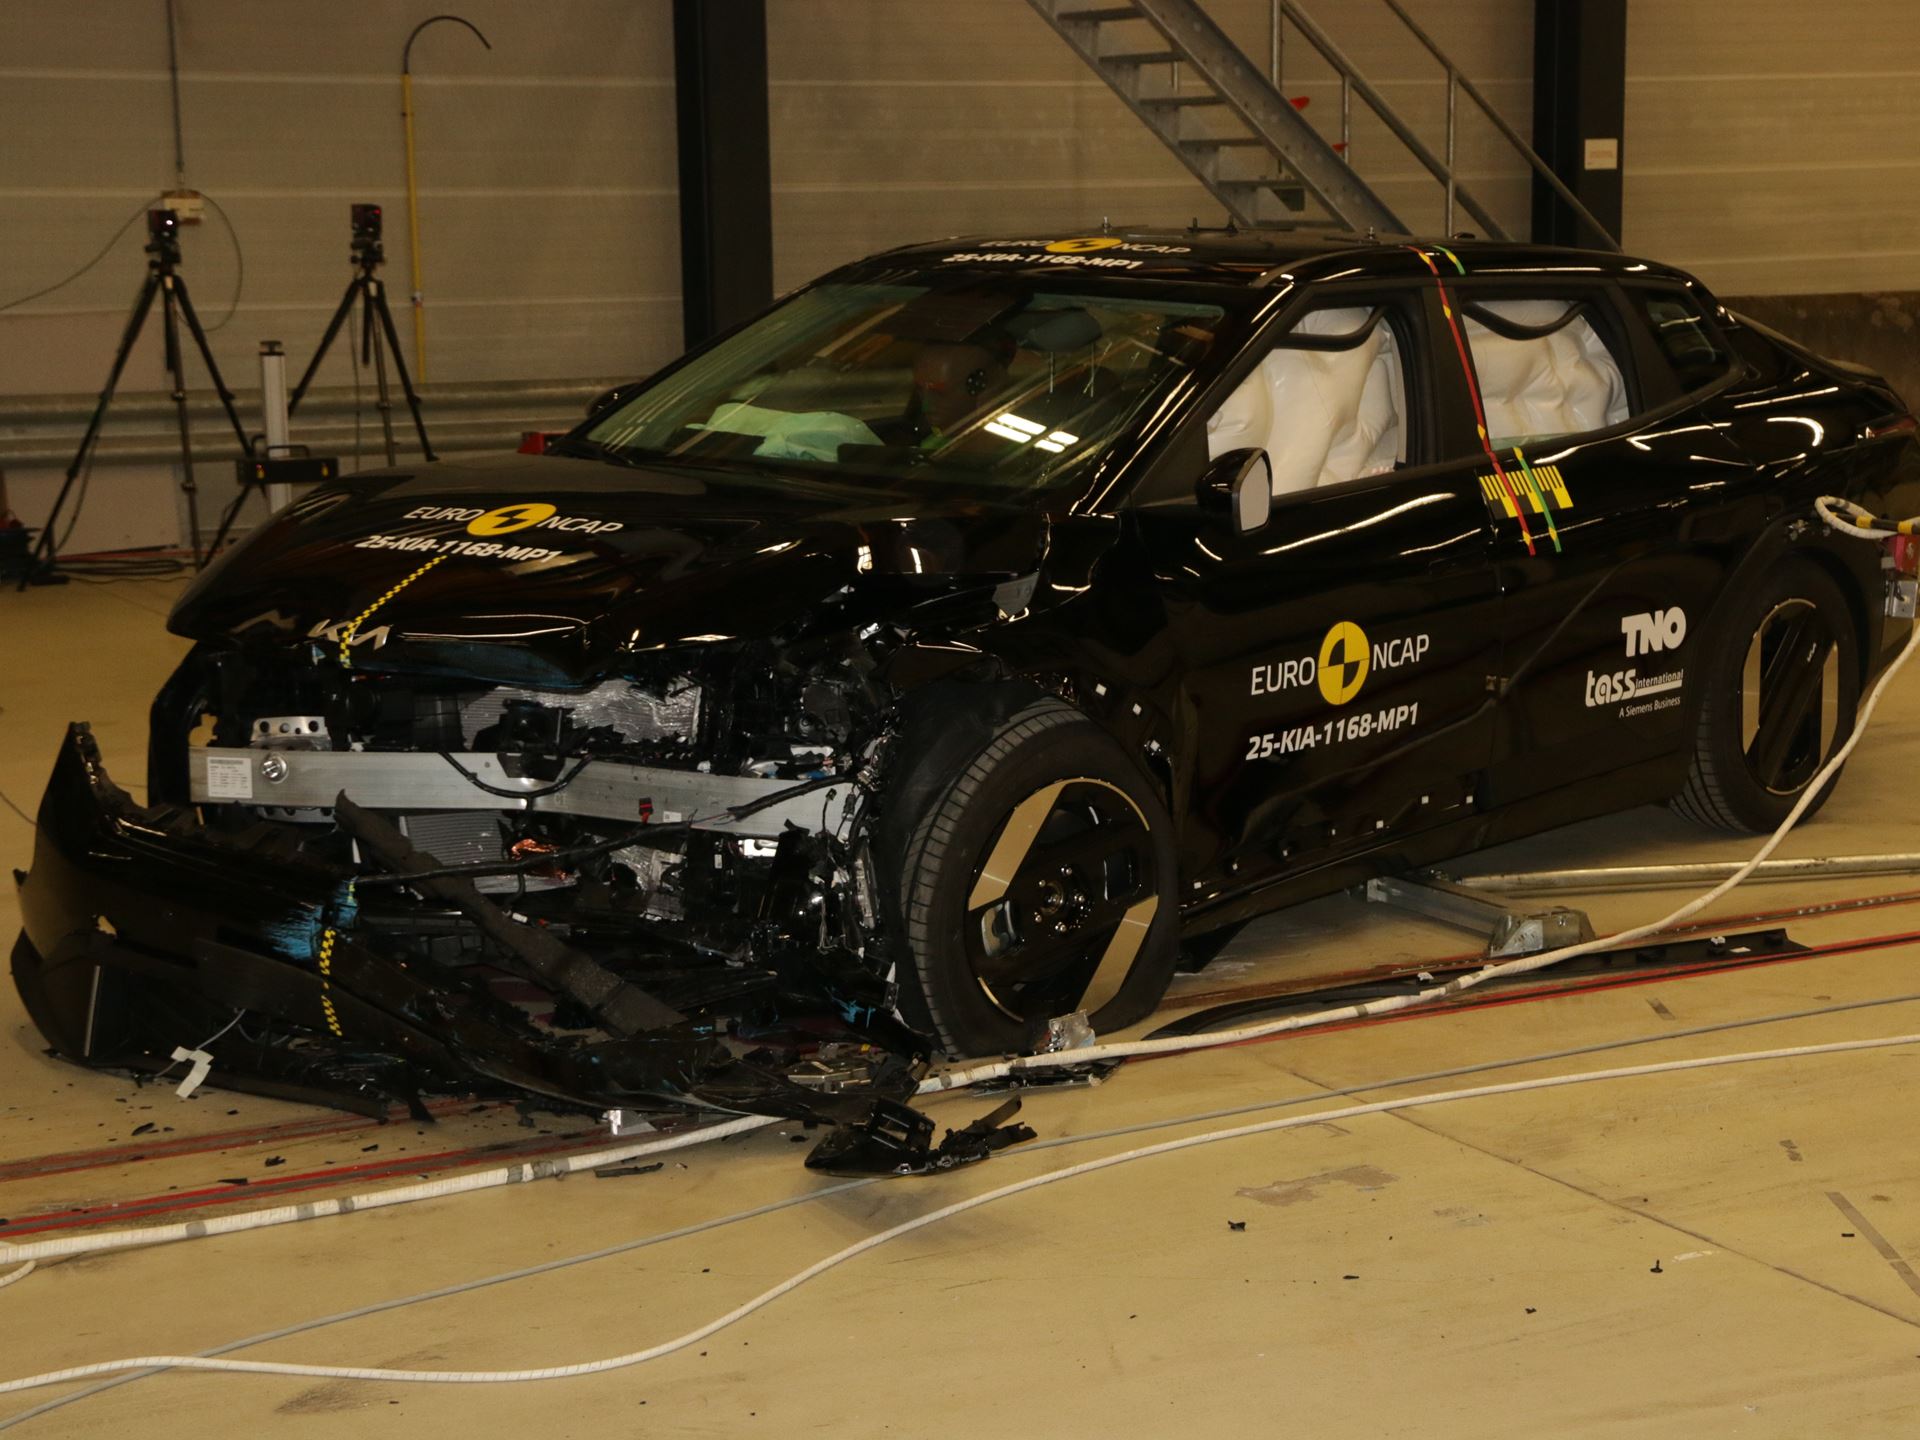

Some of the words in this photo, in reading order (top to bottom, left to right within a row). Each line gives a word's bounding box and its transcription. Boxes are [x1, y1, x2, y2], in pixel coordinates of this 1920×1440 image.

[942, 253, 1144, 270] 25-KIA-1168-MP1
[1113, 243, 1191, 253] NCAP
[403, 506, 485, 521] EURO
[537, 516, 624, 534] NCAP
[354, 535, 563, 563] 25-KIA-1168-MP1
[307, 618, 391, 651] KA
[1621, 606, 1687, 658] TNO
[1251, 656, 1315, 695] EURO
[1372, 634, 1430, 671] NCAP
[1619, 707, 1625, 718] A
[1625, 704, 1653, 717] Siemens
[1654, 697, 1681, 711] Business
[1245, 702, 1418, 760] 25-KIA-1168-MP1
